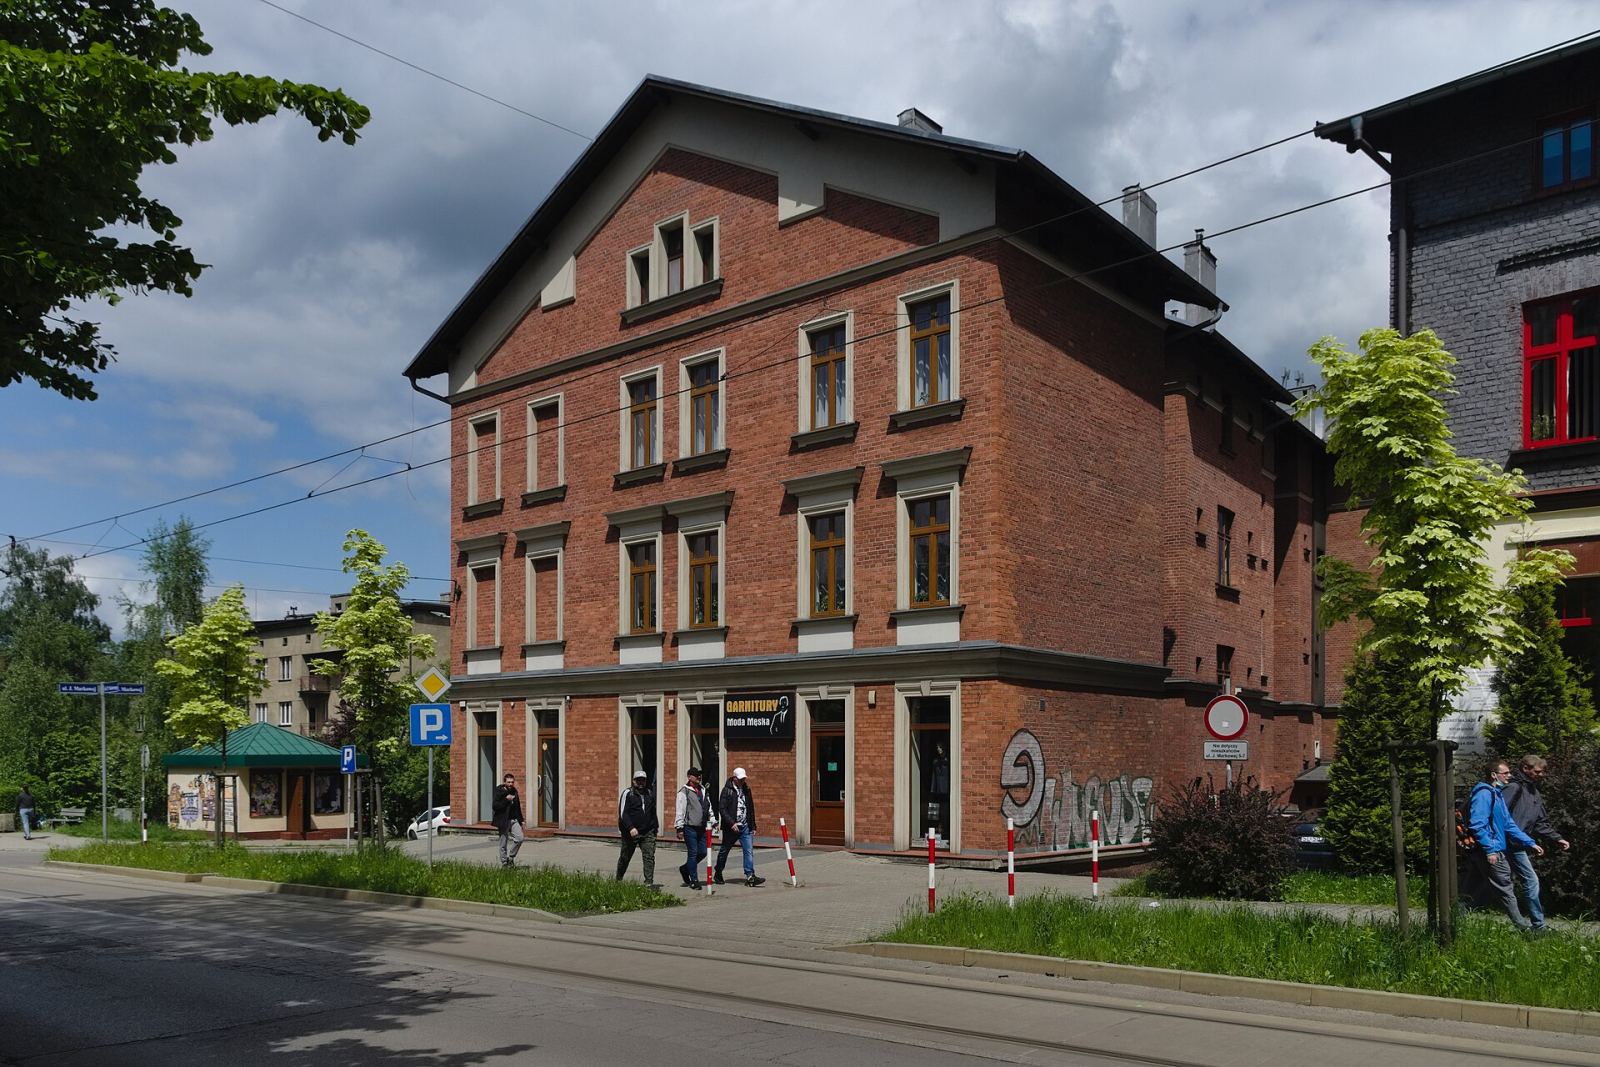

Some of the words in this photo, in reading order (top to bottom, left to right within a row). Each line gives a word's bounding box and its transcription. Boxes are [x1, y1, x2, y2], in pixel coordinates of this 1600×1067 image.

[727, 700, 778, 712] GARNITURY
[420, 709, 443, 740] P
[727, 718, 746, 726] Moda
[747, 717, 770, 727] Męska
[344, 748, 353, 766] P
